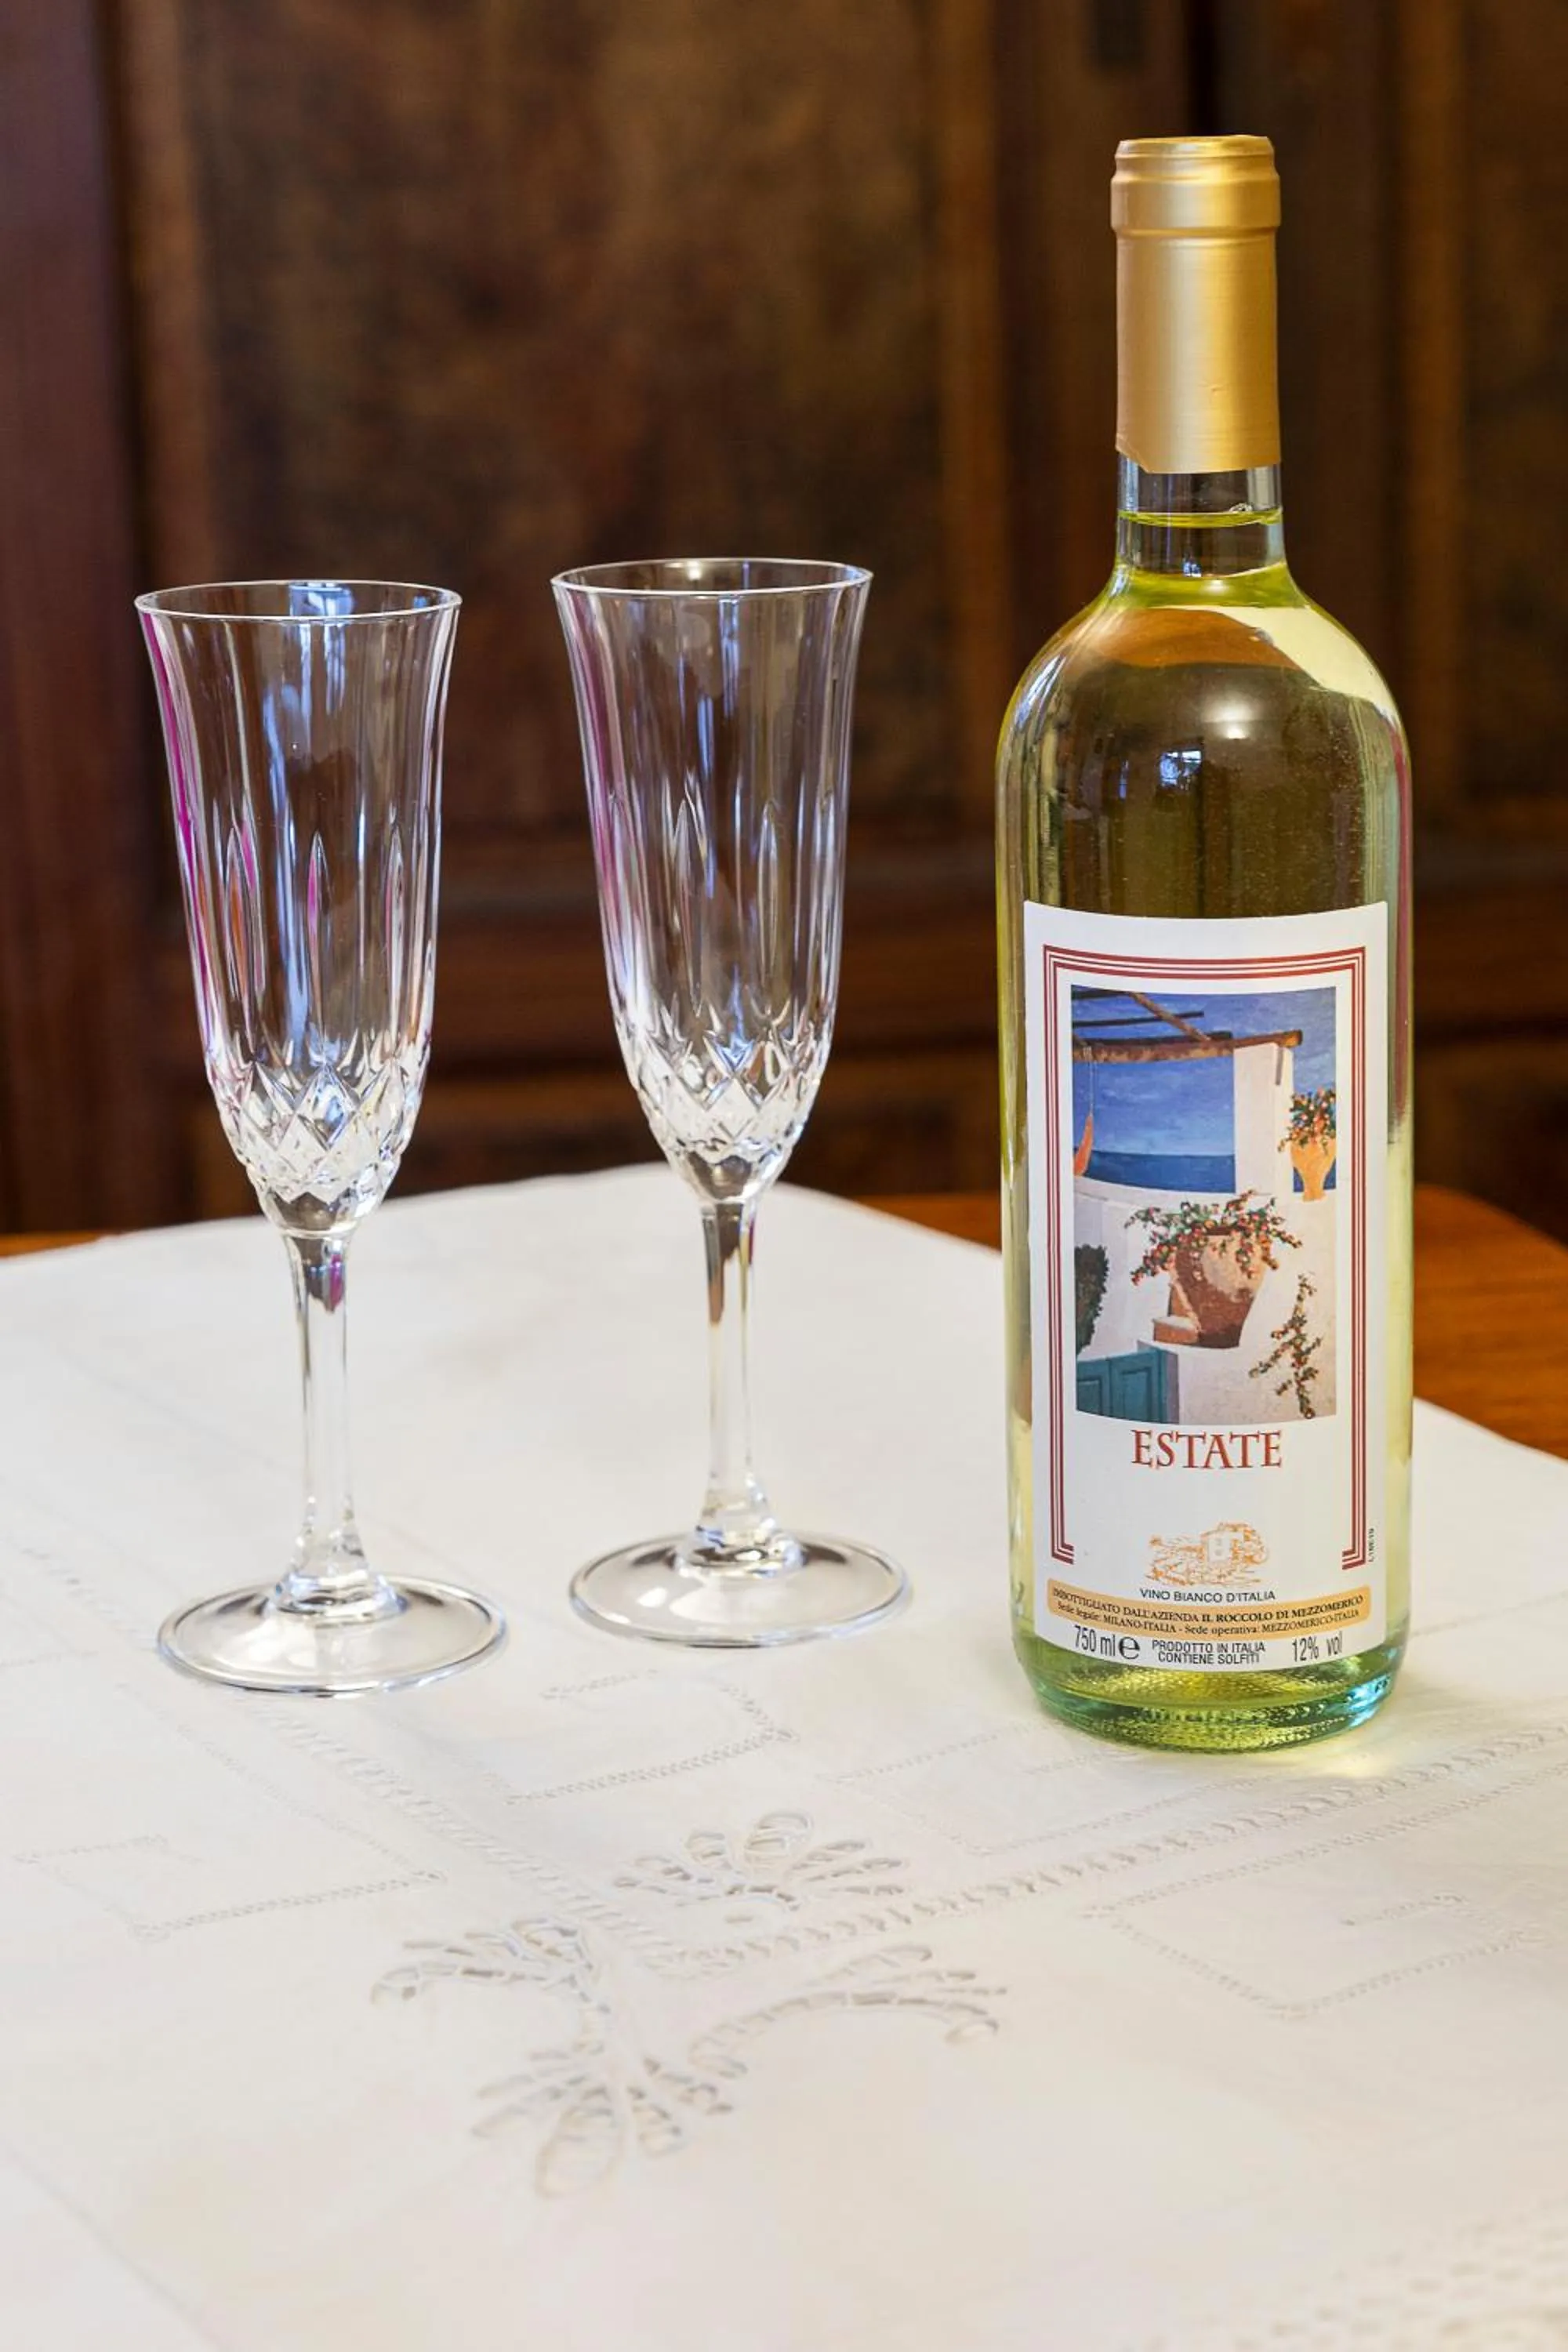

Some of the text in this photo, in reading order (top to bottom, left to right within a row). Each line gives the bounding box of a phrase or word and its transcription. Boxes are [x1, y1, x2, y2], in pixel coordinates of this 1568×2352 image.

[1131, 1429, 1283, 1469] ESTATE
[1123, 1606, 1199, 1623] DALL'AZIENDA
[1201, 1613, 1213, 1622] IL
[1215, 1611, 1273, 1623] ROCCOLO
[1276, 1609, 1290, 1620] DI
[1291, 1595, 1364, 1618] MEZZOMERICO
[1139, 1588, 1276, 1603] VINO BIANCO D'ITALIA
[1103, 1616, 1177, 1634] MILANO-ITALIA
[1184, 1624, 1209, 1635] Sede
[1261, 1609, 1360, 1634] MEZZOMERICO-ITALIA
[1073, 1624, 1142, 1660] 750 ml e
[1152, 1639, 1266, 1653] PRODOTTO IN ITALIA
[1292, 1630, 1344, 1663] 12% vol
[1158, 1650, 1261, 1665] CONTIENE SOLFITI
